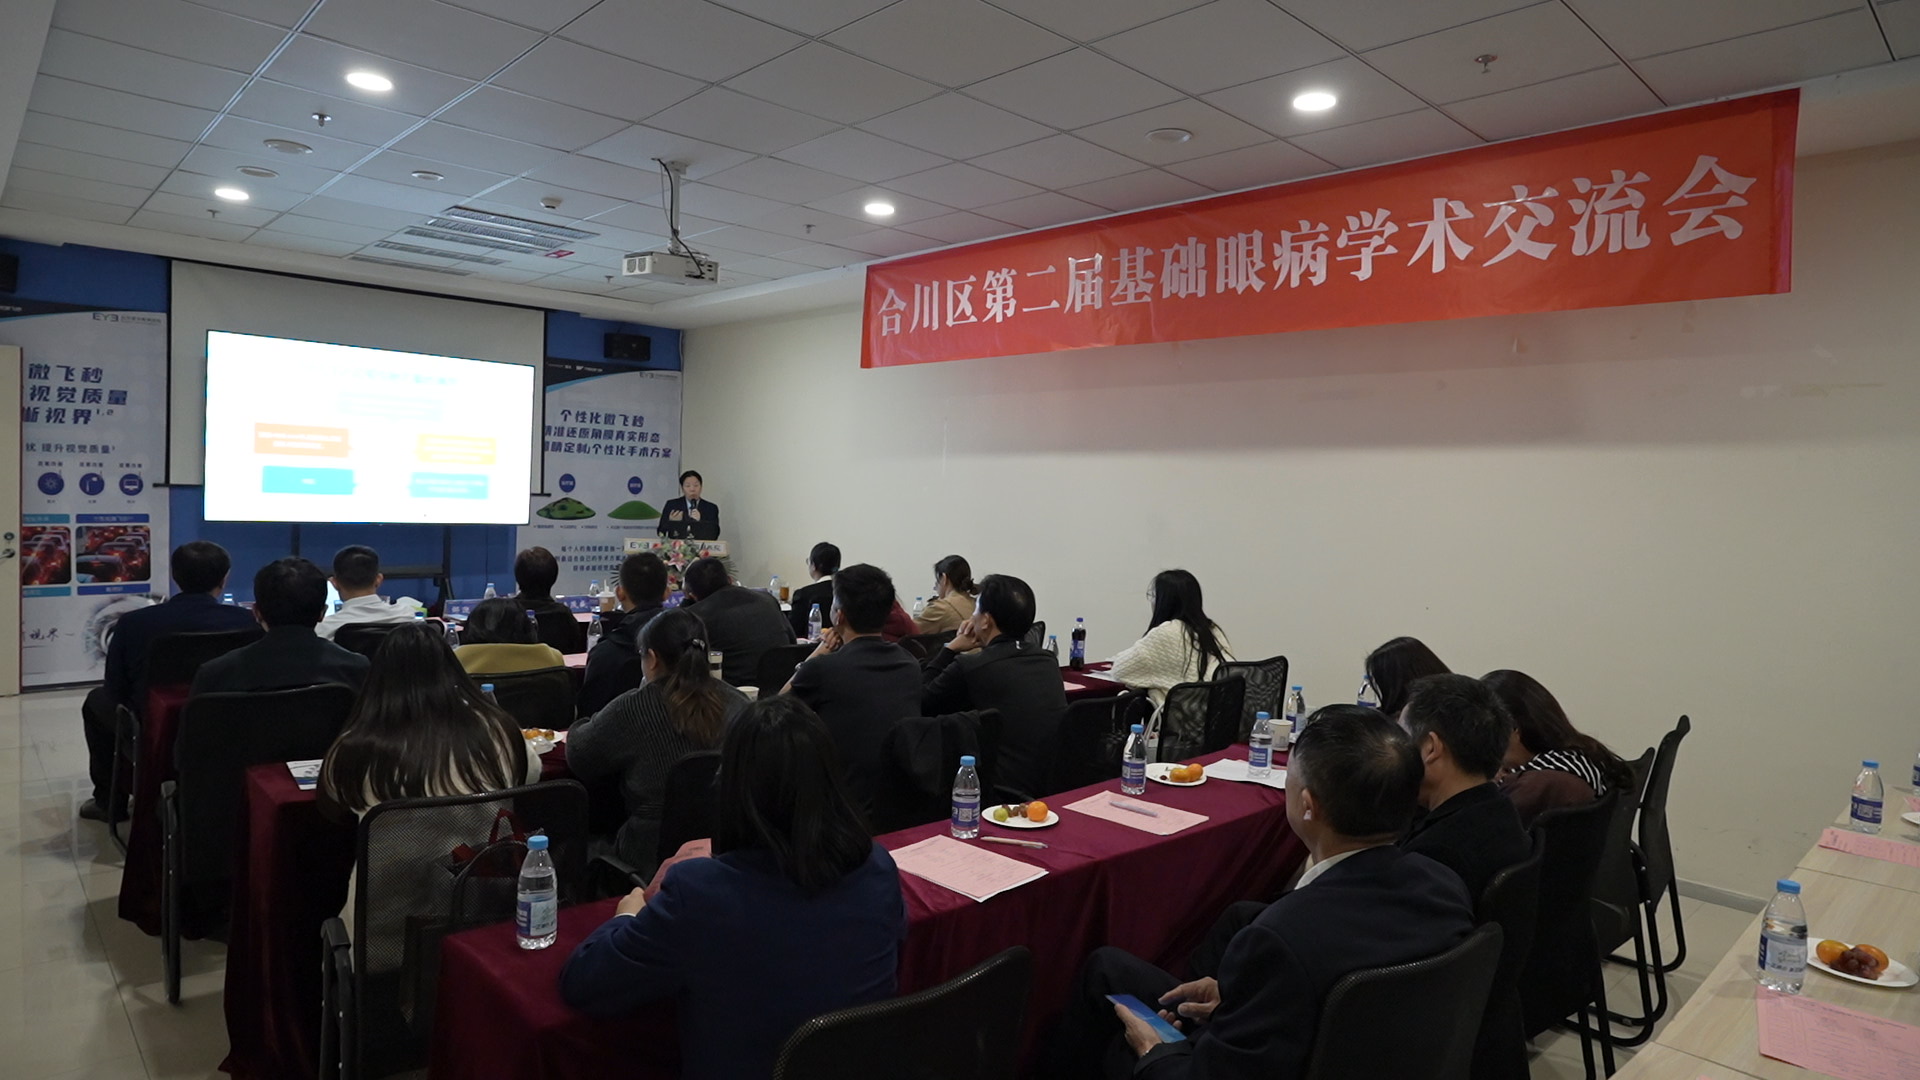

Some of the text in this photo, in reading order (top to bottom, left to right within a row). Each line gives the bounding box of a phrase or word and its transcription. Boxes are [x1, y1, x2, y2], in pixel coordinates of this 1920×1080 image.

[878, 155, 1757, 336] 合川区第二届基础眼病学术交流会
[28, 363, 103, 383] 微飞秒
[29, 384, 128, 405] 视觉质量
[560, 409, 645, 428] 个性化微飞秒
